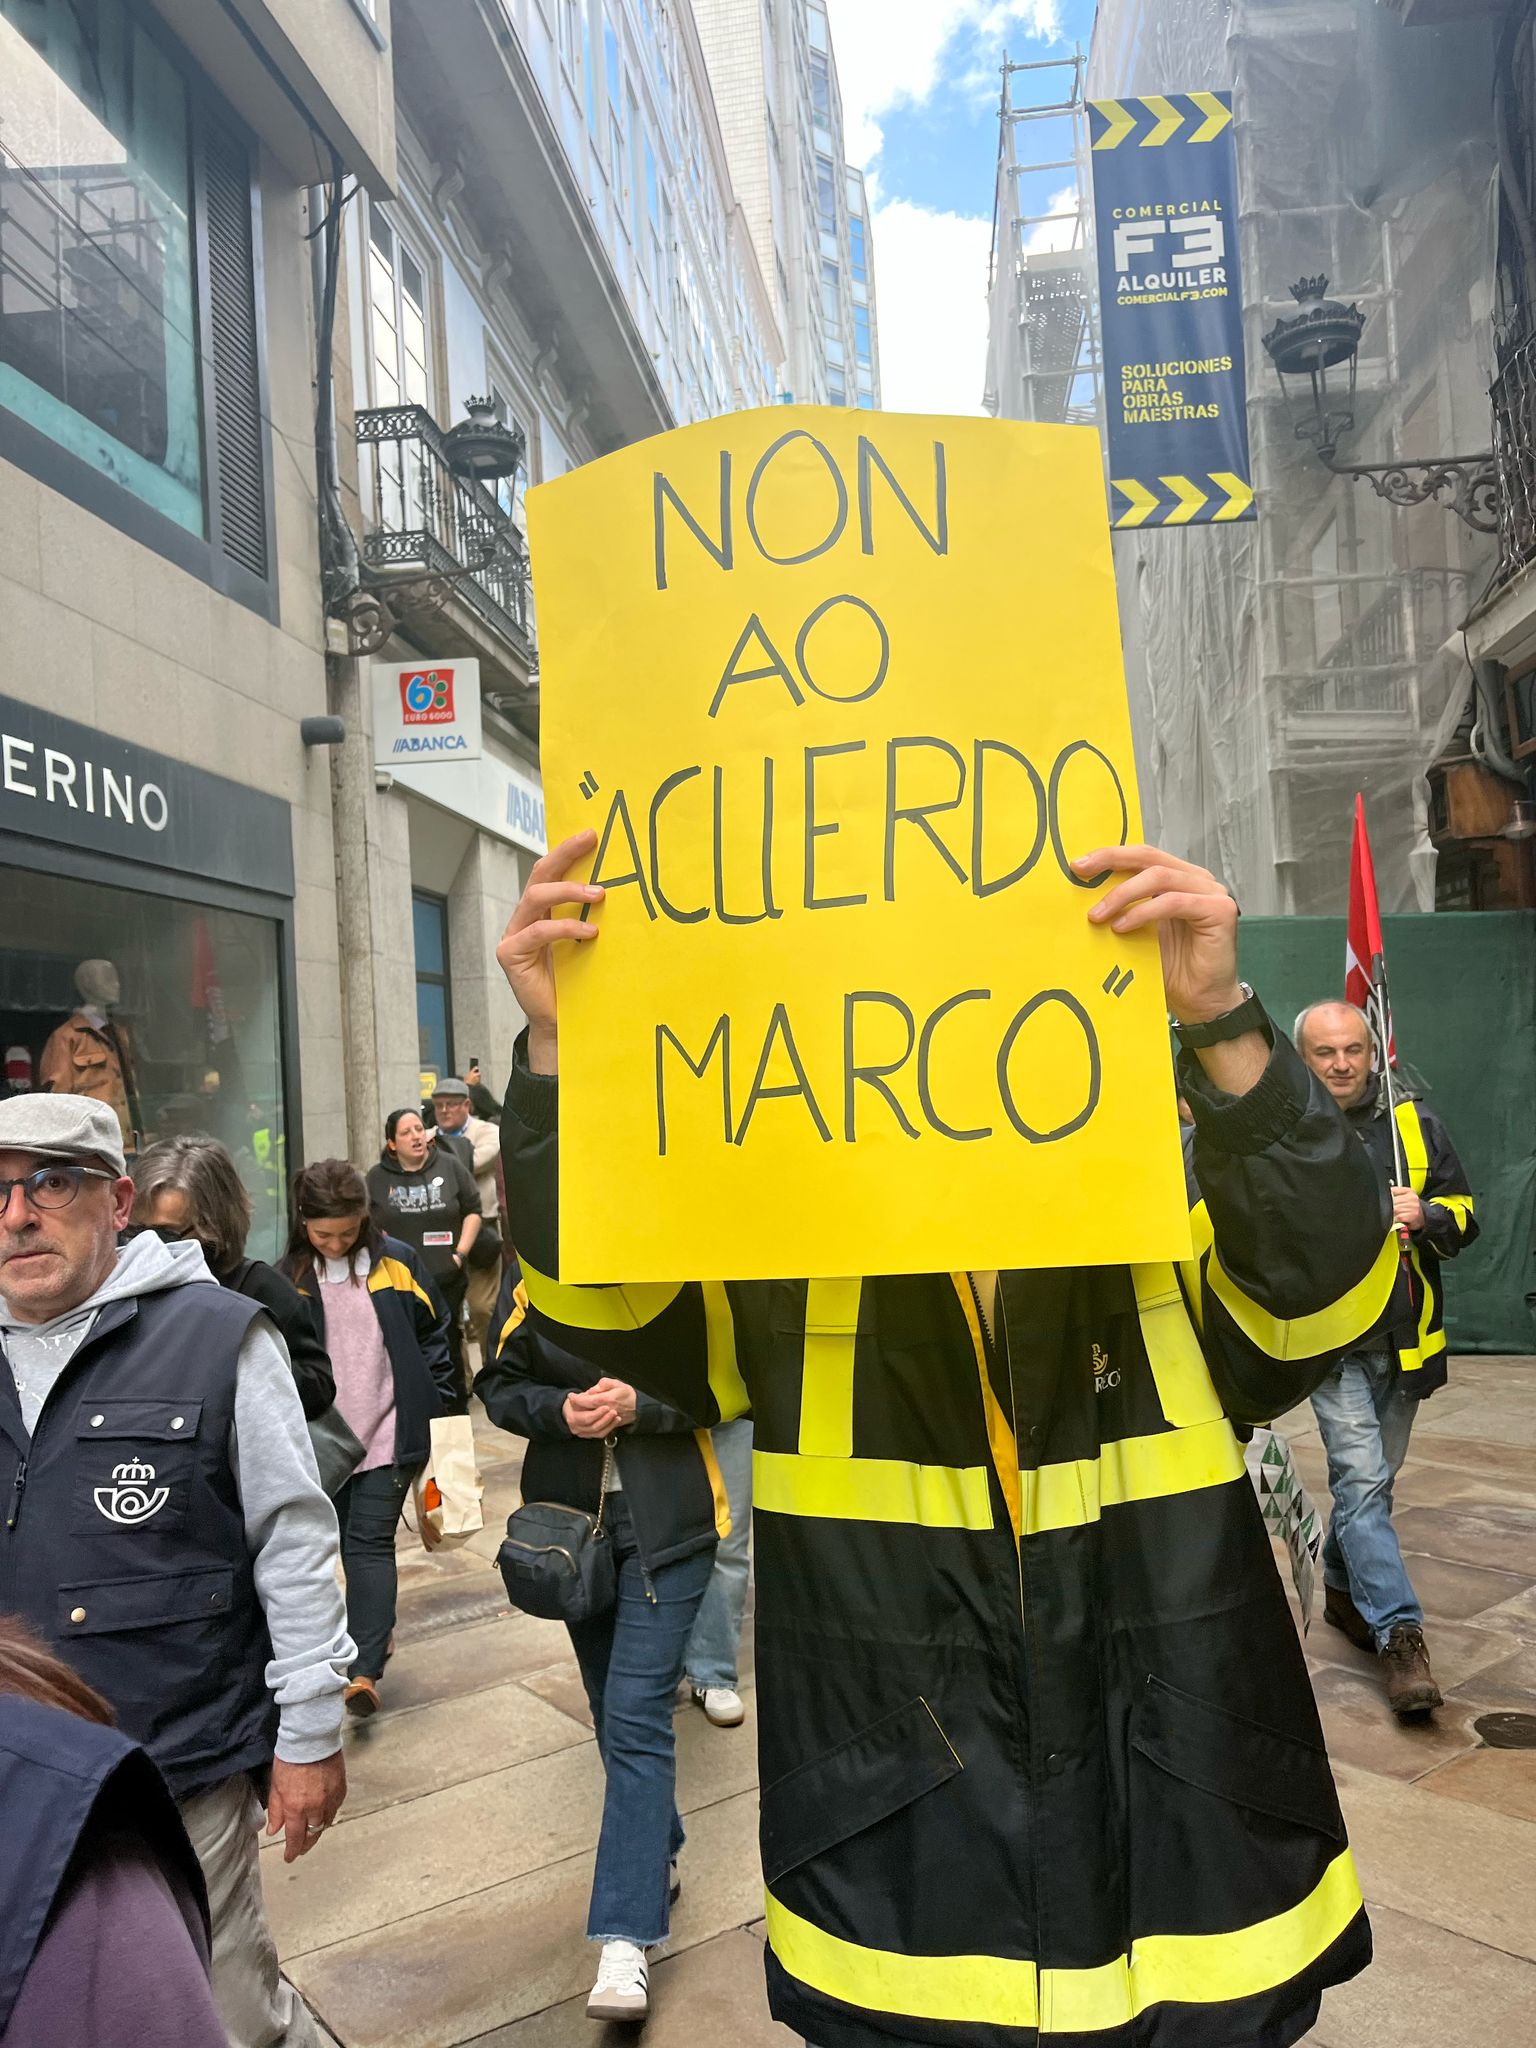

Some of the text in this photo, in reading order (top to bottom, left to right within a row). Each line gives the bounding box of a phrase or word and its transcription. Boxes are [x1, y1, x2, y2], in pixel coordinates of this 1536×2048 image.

[1112, 200, 1222, 219] COMERCIAL
[1113, 214, 1225, 272] F3
[1117, 267, 1227, 292] ALQUILER
[1117, 287, 1228, 305] COMERCIALF3.COM
[1121, 356, 1232, 379] SOLUCIONES
[1122, 378, 1168, 394] PARA
[1122, 391, 1184, 408] OBRAS
[1123, 404, 1219, 424] MAESTRAS
[653, 429, 948, 591] NON
[708, 594, 890, 719] AO
[404, 711, 453, 723] EURO 6000
[1, 733, 168, 832] ERINO
